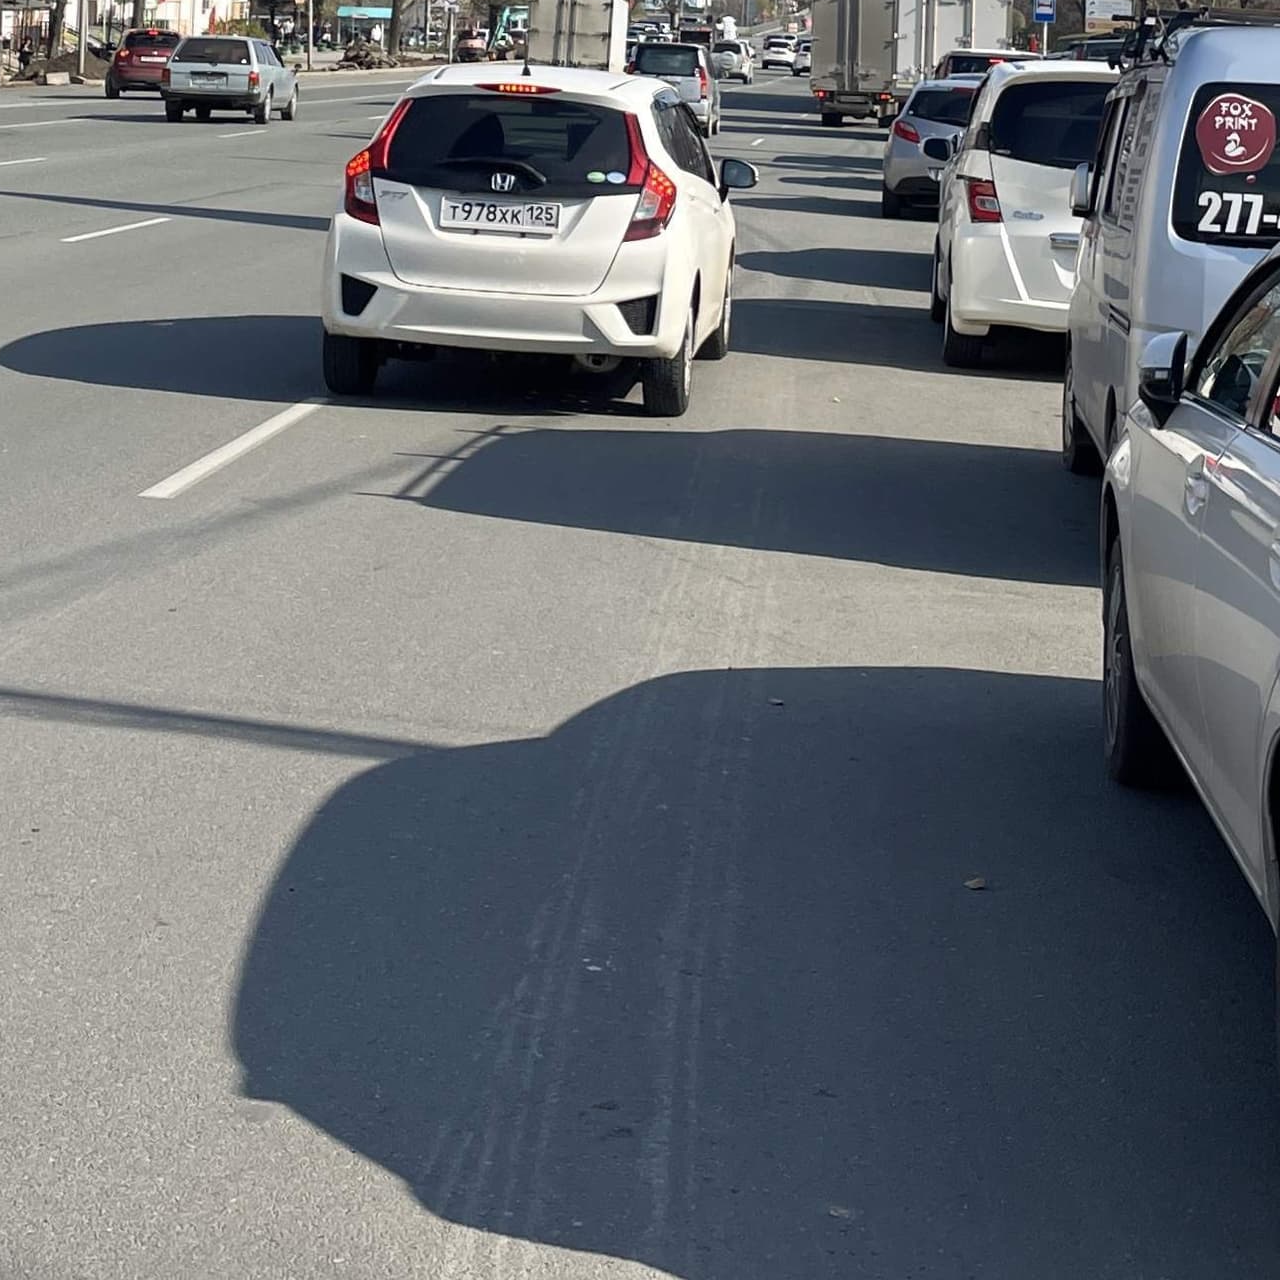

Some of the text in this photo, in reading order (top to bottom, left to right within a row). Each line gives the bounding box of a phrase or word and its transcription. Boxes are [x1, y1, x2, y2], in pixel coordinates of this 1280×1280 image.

[1220, 101, 1253, 117] FOX
[1214, 115, 1258, 132] PRINT
[526, 205, 554, 222] 125
